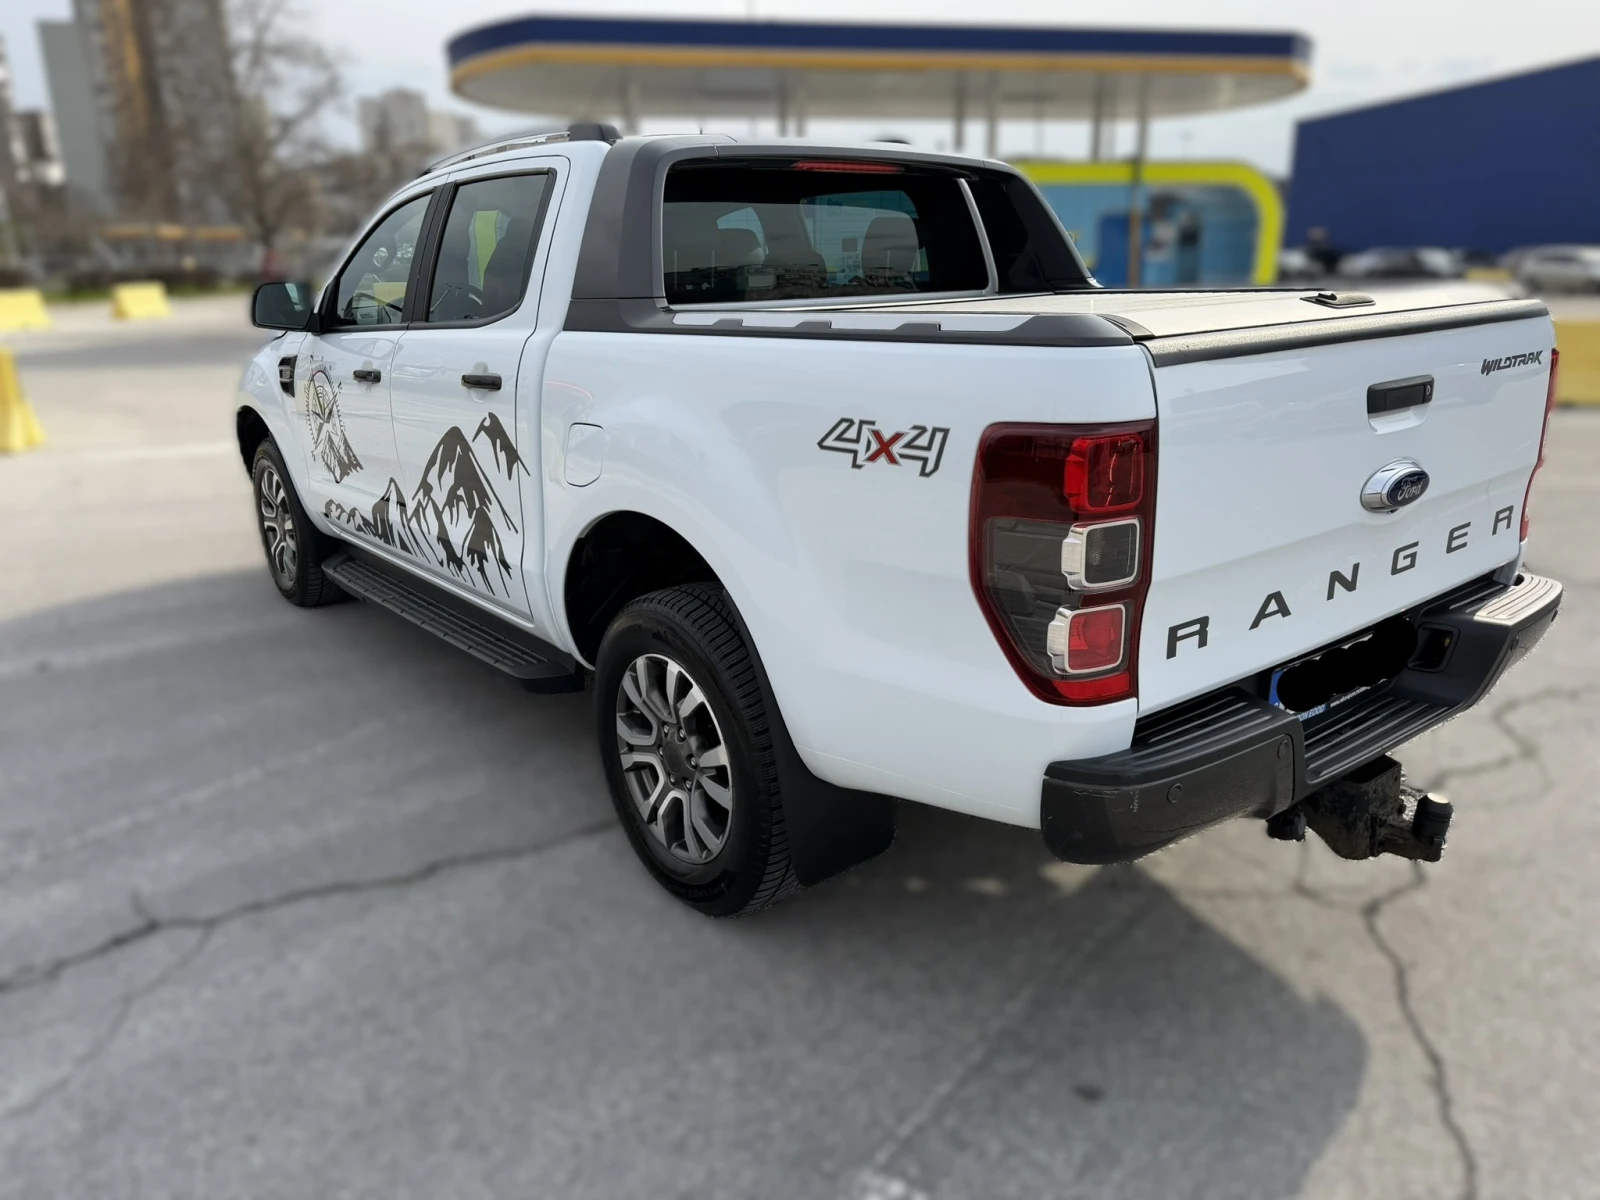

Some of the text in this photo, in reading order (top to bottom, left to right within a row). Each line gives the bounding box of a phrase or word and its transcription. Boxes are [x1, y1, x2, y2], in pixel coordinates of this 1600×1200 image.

[1481, 350, 1543, 376] WILDTRAK
[1397, 479, 1424, 501] Ford
[1166, 505, 1514, 659] RANGER
